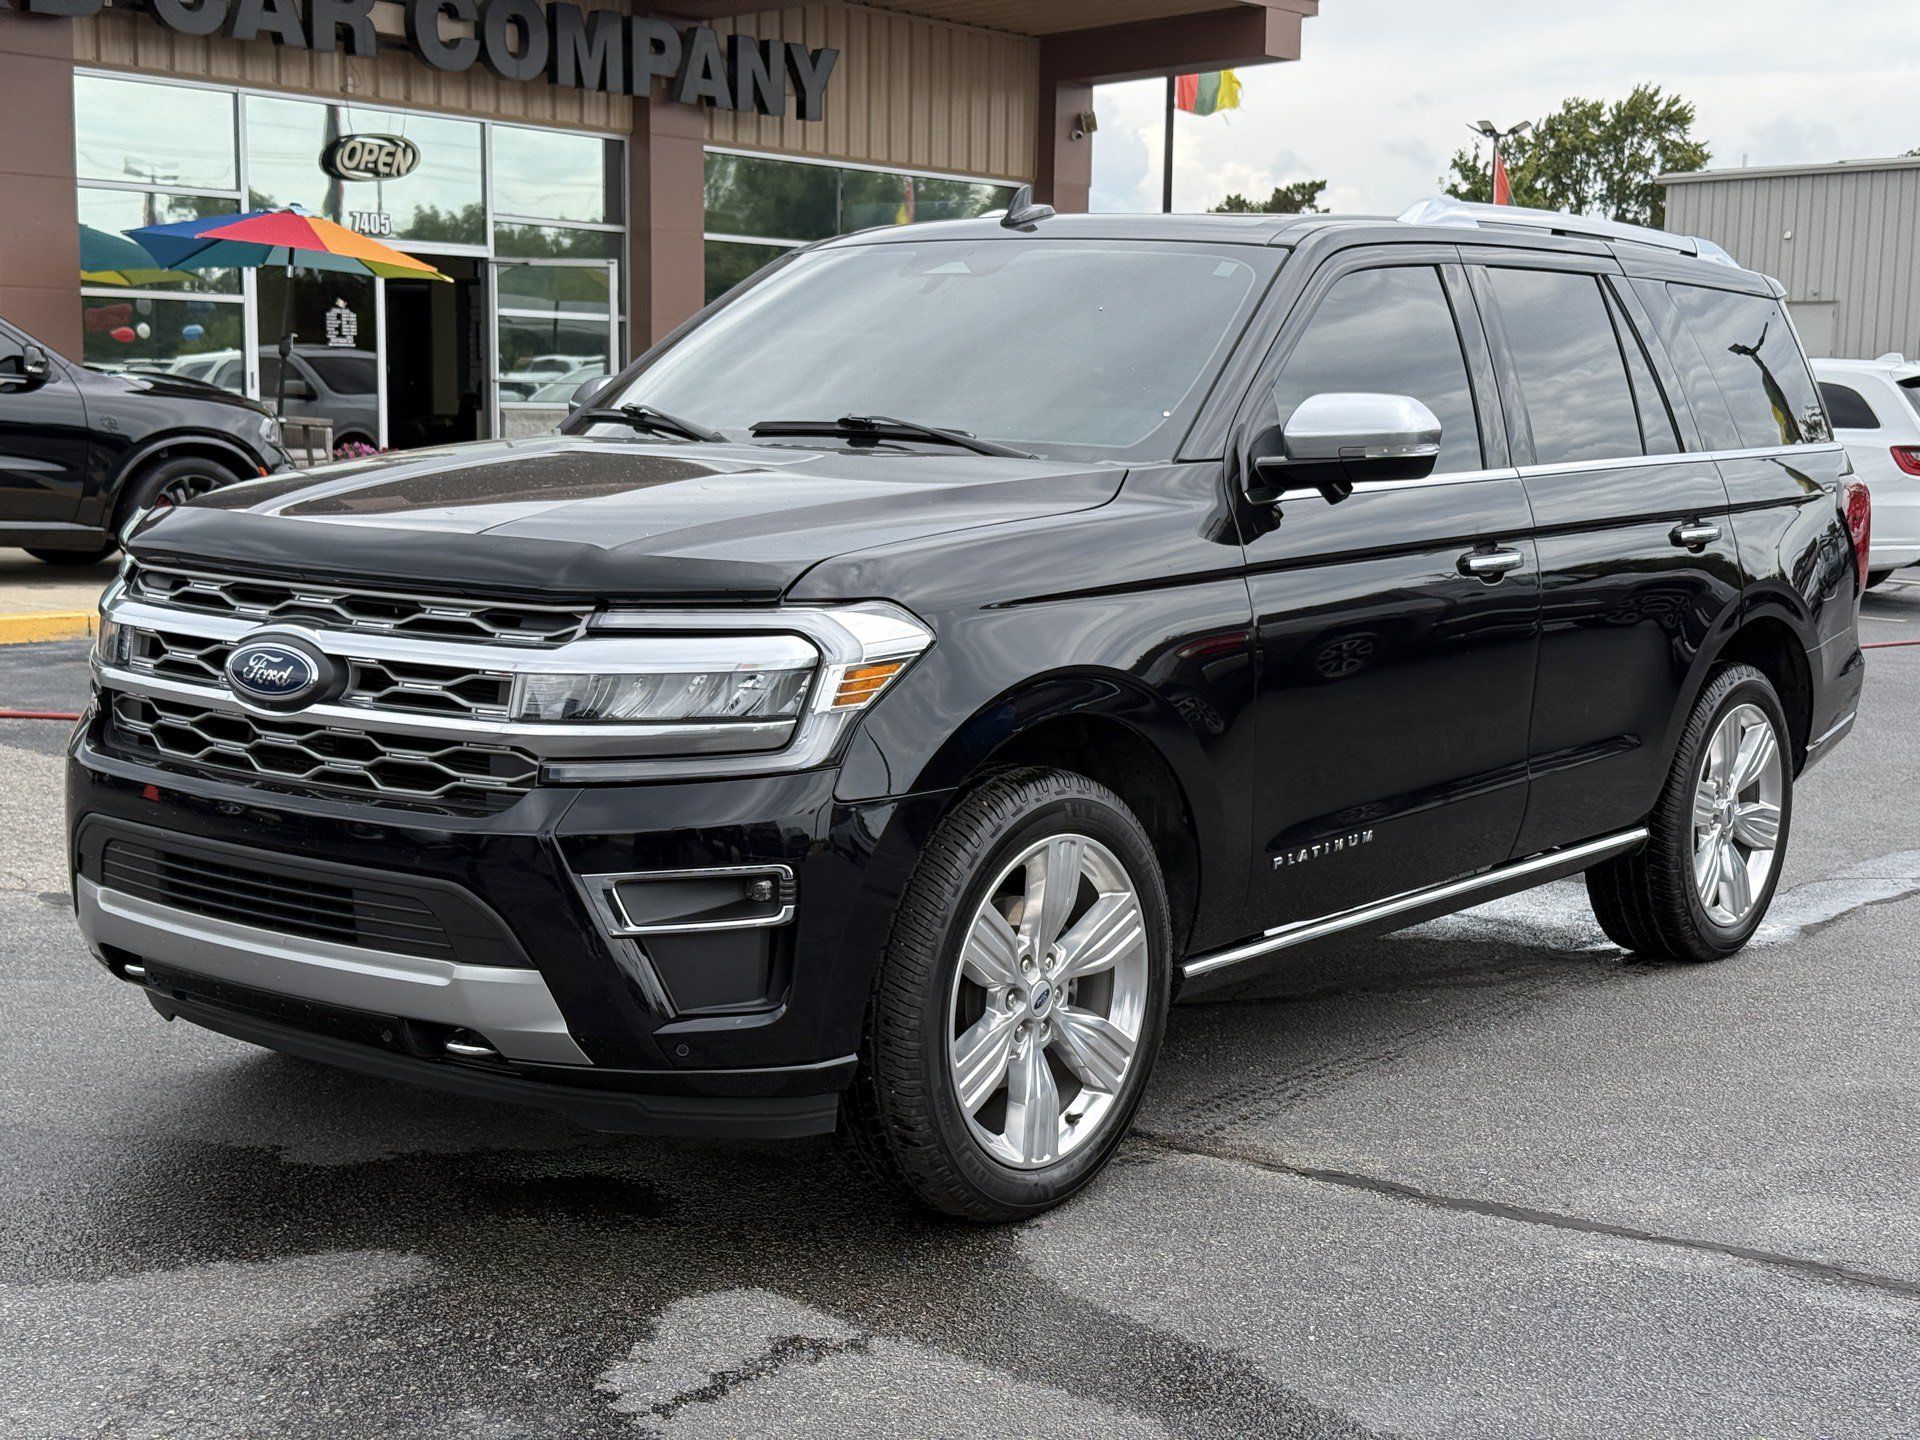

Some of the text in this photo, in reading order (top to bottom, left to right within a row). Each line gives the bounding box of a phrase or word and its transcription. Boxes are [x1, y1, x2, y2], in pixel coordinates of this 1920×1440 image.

[406, 0, 839, 121] COMPANY
[342, 140, 413, 175] OPEN
[352, 211, 392, 235] 7405
[243, 652, 294, 686] Ford
[1273, 829, 1374, 870] PLATINUM
